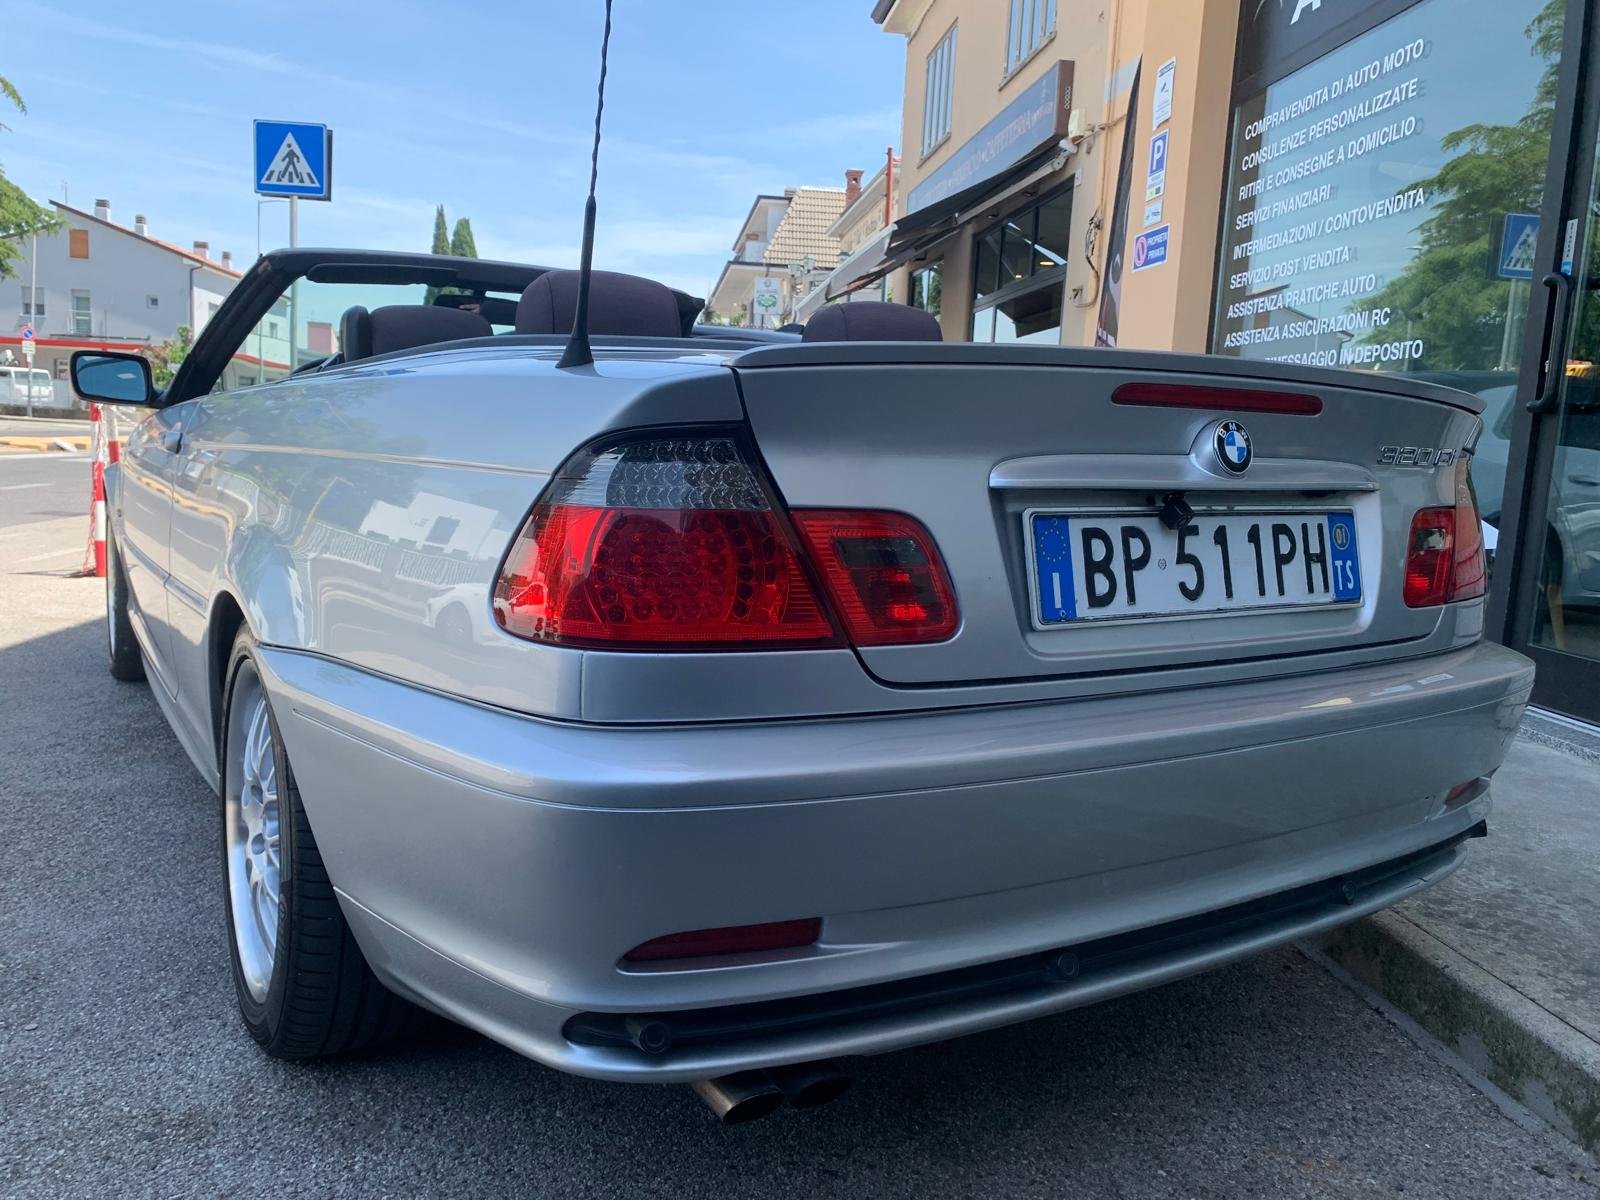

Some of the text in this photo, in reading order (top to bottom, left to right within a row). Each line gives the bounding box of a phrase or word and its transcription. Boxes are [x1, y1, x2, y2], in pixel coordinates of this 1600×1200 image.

[1245, 38, 1425, 140] COMPRAVENDITA DI AUTO MOTO
[1241, 78, 1418, 171] CONSULENZE PERSONALIZZATE
[1152, 139, 1164, 171] P
[1238, 116, 1416, 200] RITIRI E CONSEGNE A DOMICILIO
[1232, 222, 1317, 260] INTERMEDIAZIONI
[1325, 188, 1425, 233] CONTOVENDITA
[1235, 184, 1331, 230] SERVIZI FINANZIARI
[1230, 246, 1349, 289] SERVIZIO POST VENDITA
[1227, 274, 1376, 319] ASSISTENZA PRATICHE AUTO
[1224, 307, 1391, 348] ASSISTENZA ASSICURAZIONI RC
[1339, 347, 1354, 365] IN
[1354, 339, 1424, 363] DEPOSITO
[1081, 525, 1151, 609] BP
[1334, 560, 1354, 591] TS
[1052, 572, 1062, 609] I
